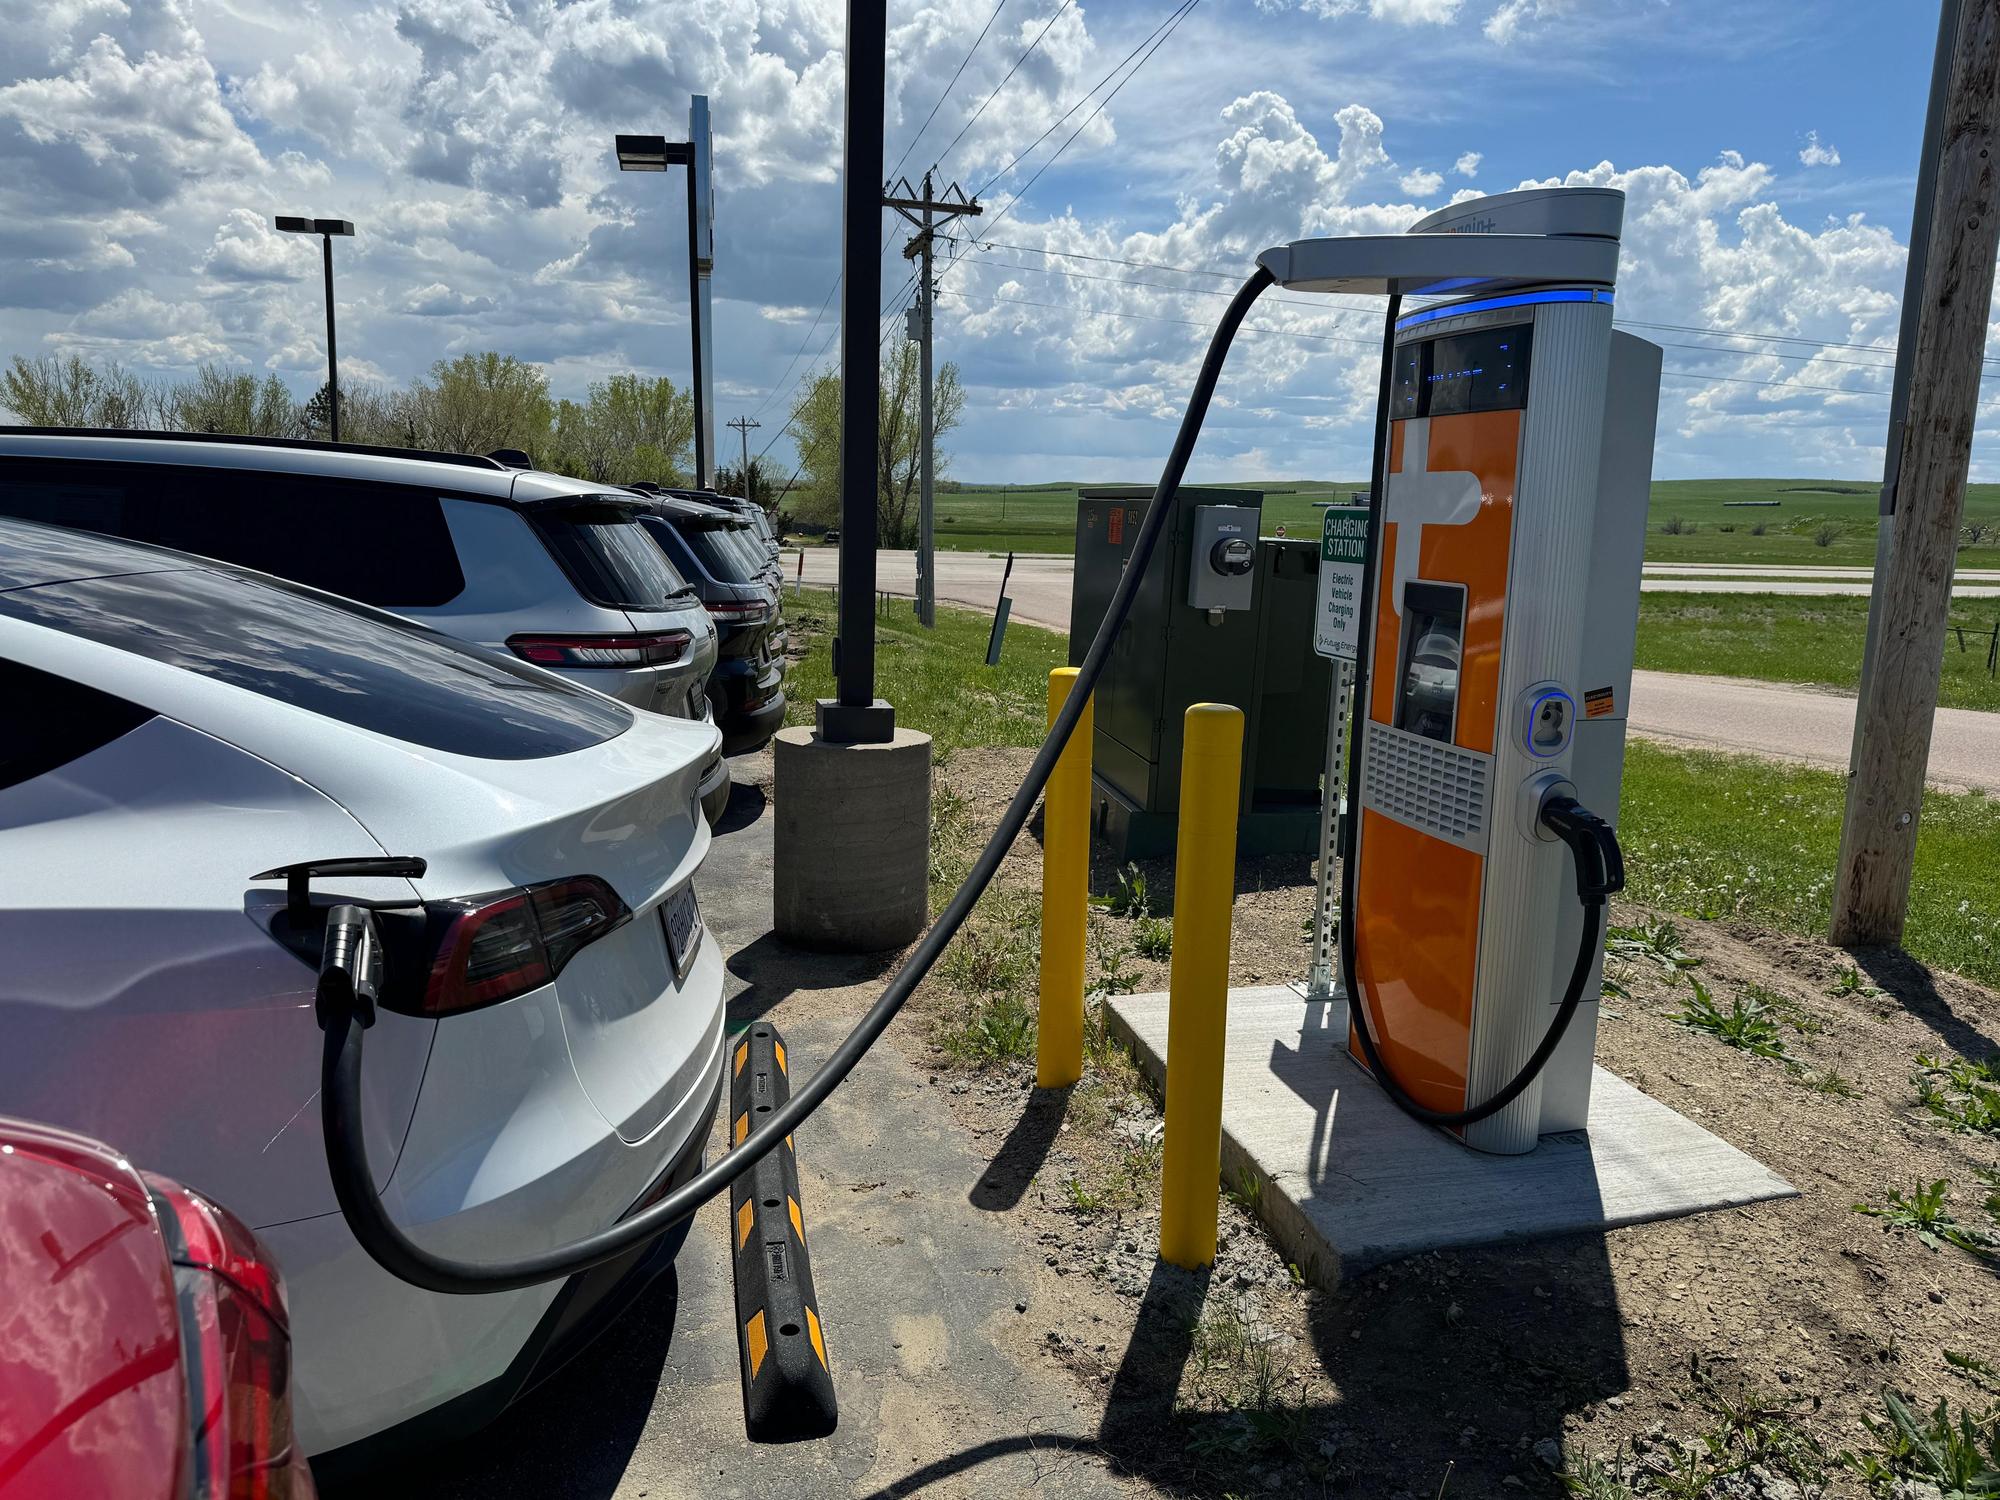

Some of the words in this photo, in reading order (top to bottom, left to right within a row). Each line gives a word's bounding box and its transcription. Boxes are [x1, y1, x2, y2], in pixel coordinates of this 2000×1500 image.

[1325, 519, 1368, 538] CHARGING
[1327, 538, 1364, 558] STATION
[1332, 572, 1353, 586] Electric
[1331, 588, 1353, 601] Vehicle
[1328, 601, 1354, 618] Charging
[1333, 617, 1346, 632] Only
